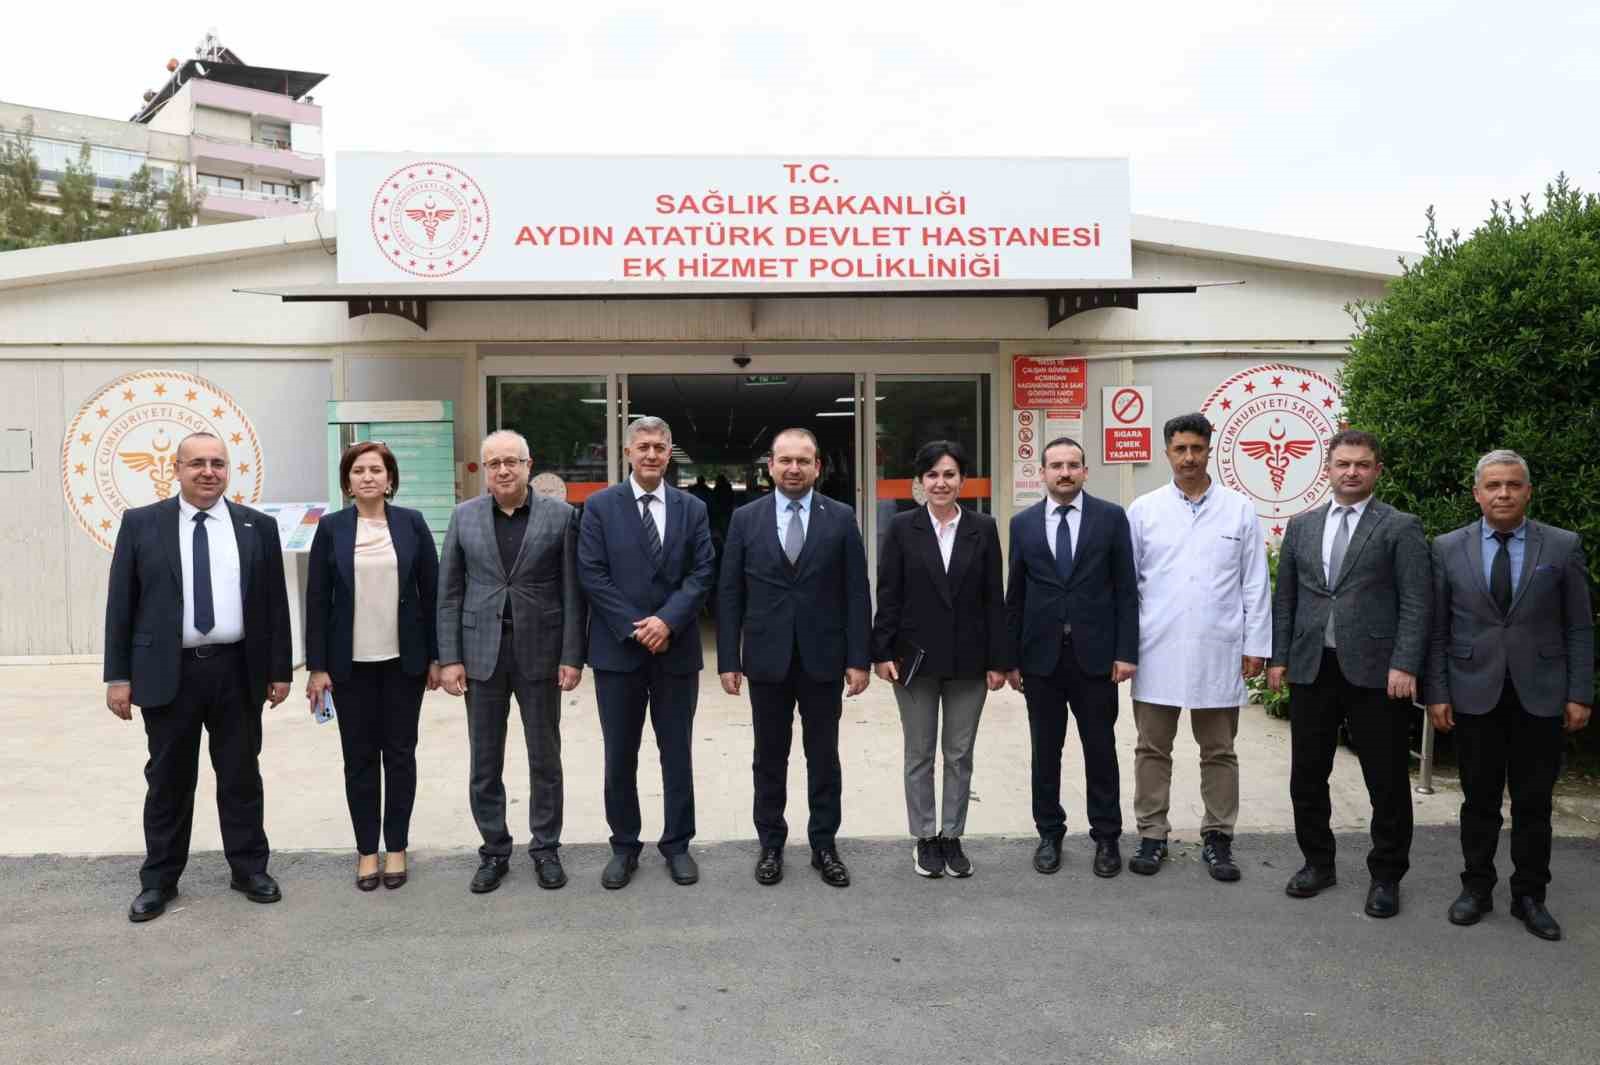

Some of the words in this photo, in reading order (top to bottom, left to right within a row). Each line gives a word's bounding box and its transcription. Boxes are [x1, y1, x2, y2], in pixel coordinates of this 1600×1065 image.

[783, 164, 839, 183] T.C.
[655, 189, 778, 215] SAĞLIK
[789, 191, 967, 216] BAKANLIĞI
[515, 225, 614, 246] AYDIN
[624, 222, 774, 246] ATATÜRK
[785, 226, 911, 247] DEVLET
[922, 224, 1101, 247] HASTANESİ
[623, 258, 667, 278] EK
[678, 253, 799, 278] HİZMET
[809, 253, 1001, 279] POLİKLİNİĞİ
[1222, 398, 1288, 453] CUMHURİYETİ
[1291, 401, 1328, 435] SAĞLIK
[1109, 450, 1148, 458] YASAKTIR
